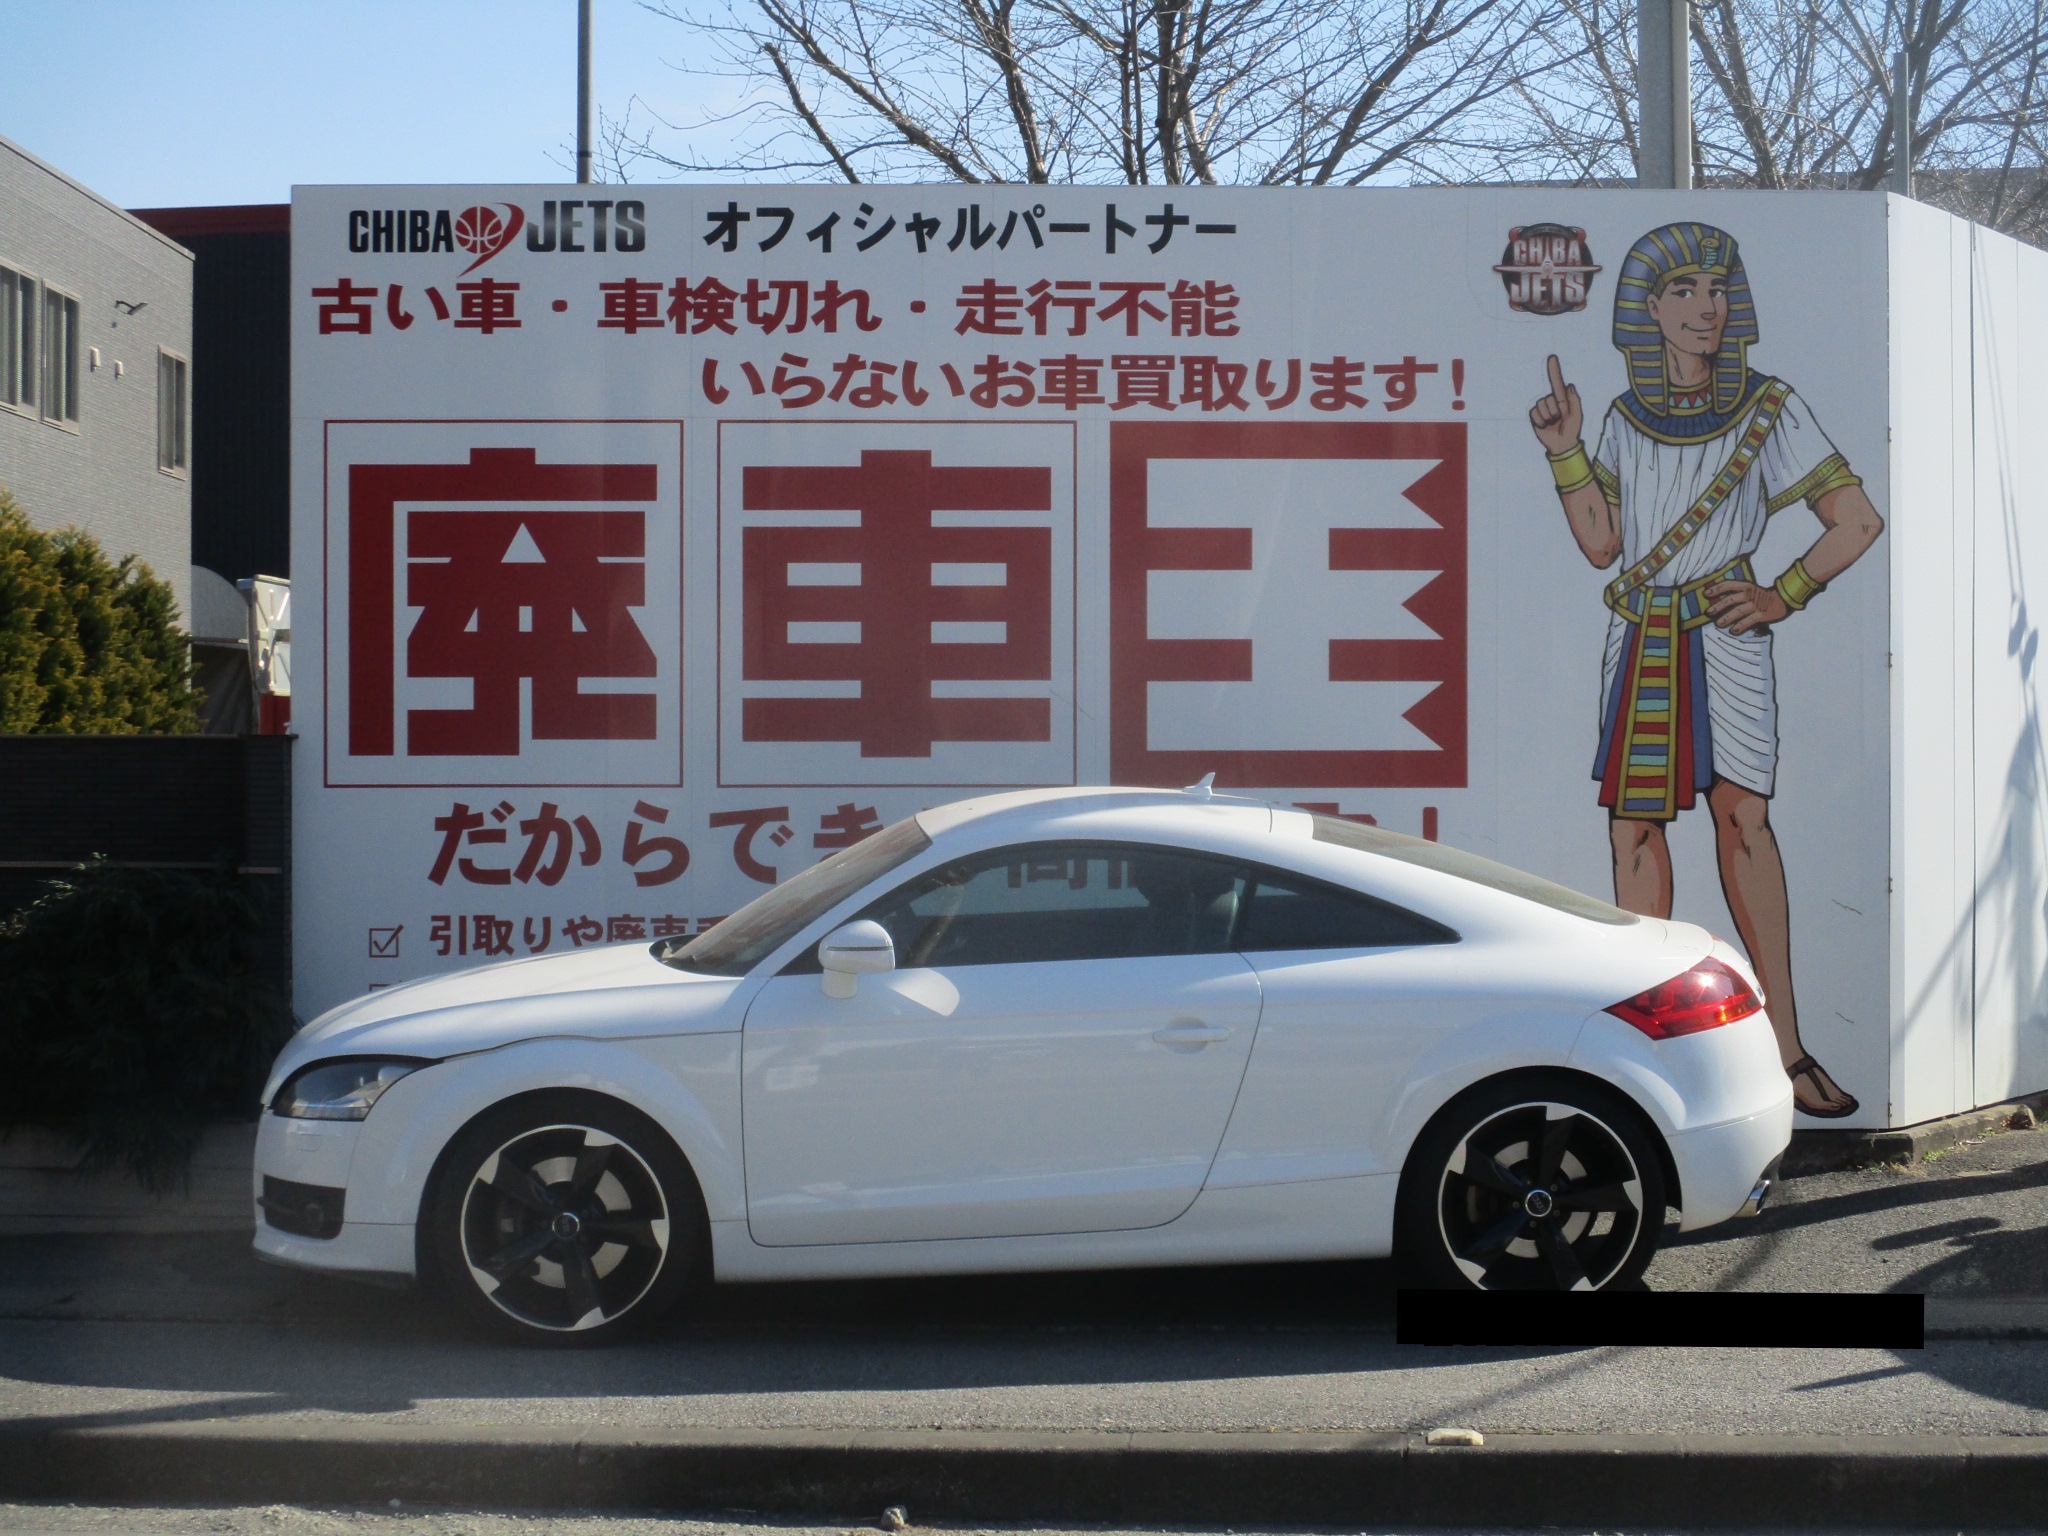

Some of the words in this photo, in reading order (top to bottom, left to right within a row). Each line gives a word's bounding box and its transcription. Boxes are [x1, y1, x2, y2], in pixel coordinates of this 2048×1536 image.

[348, 209, 454, 254] CHIBA
[526, 200, 646, 254] JETS
[703, 202, 1238, 255] オフィシャルパートナー
[1510, 270, 1585, 306] JETS
[702, 351, 1467, 413] いらないお車買取ります！
